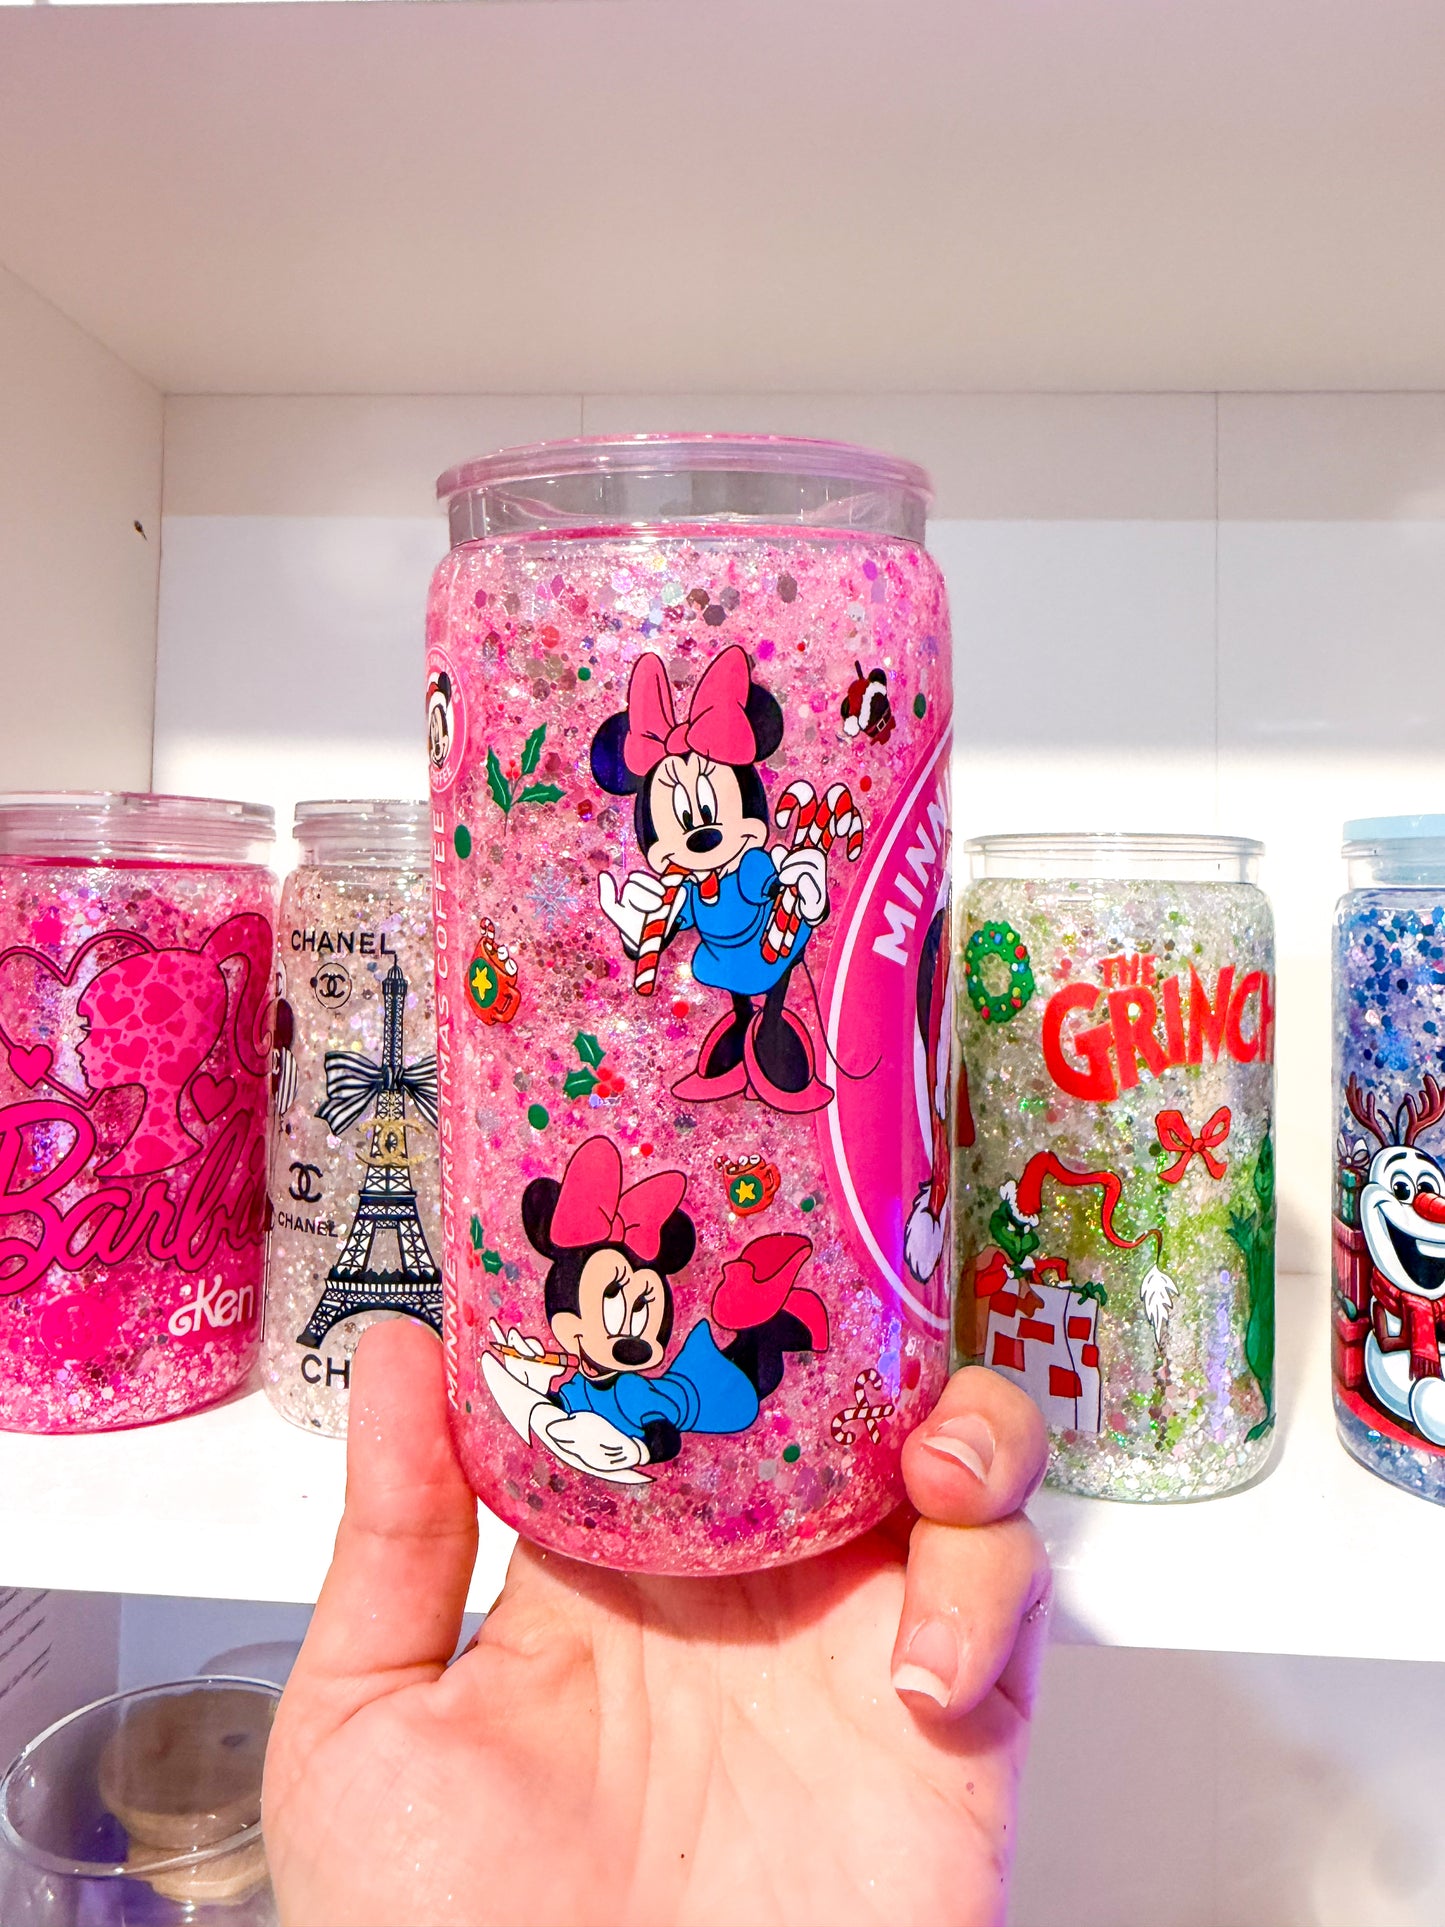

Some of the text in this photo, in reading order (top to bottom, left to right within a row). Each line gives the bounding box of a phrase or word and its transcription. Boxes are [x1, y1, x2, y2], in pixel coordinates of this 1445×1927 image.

[290, 929, 396, 955] CHANEL
[1098, 952, 1159, 988] THE
[432, 809, 458, 1411] MINNIE CHRISTMAS COFFEE
[277, 1211, 339, 1238] CHANEL
[168, 1275, 254, 1337] Ken
